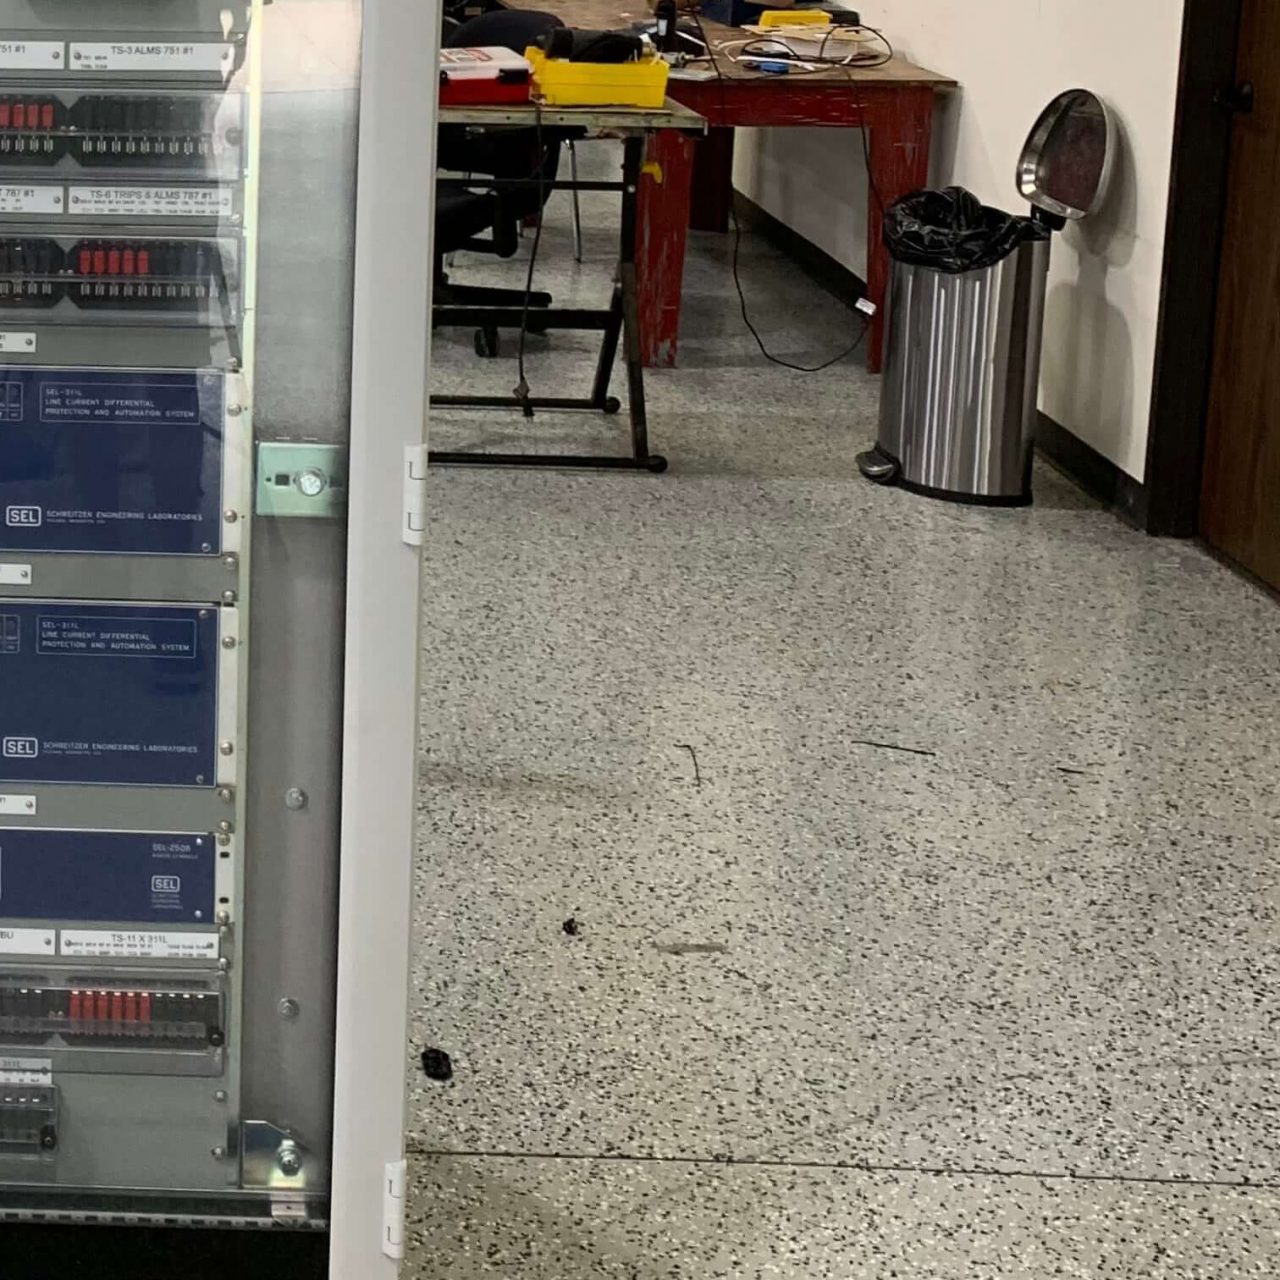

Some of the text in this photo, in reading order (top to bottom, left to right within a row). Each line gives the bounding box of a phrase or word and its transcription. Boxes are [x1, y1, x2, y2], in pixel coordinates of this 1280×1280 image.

[14, 45, 26, 53] #1
[110, 46, 132, 54] TS-3
[134, 46, 161, 55] ALMS
[182, 47, 194, 55] #1
[24, 189, 35, 198] #1
[114, 190, 142, 200] TRIPS
[154, 191, 180, 200] ALMS
[201, 192, 212, 200] #1
[45, 398, 155, 408] LINE CURRENT DIFFERENTIAL
[45, 408, 194, 418] PROTECTION AND AUTOMATION SYSTEM
[10, 510, 37, 522] SEL
[96, 511, 144, 520] ENGINEERING
[148, 512, 203, 521] LABORATORIES
[62, 632, 96, 640] CURRENT
[100, 632, 150, 641] DIFFERENTIAL
[42, 640, 190, 652] PROTECTION AND AUTOMATION SYSTEM
[6, 740, 34, 754] SEL
[92, 743, 140, 752] ENGINEERING
[144, 744, 198, 754] LABORATORIES
[155, 878, 176, 889] SEL
[112, 934, 168, 944] TS-11 X 311L
